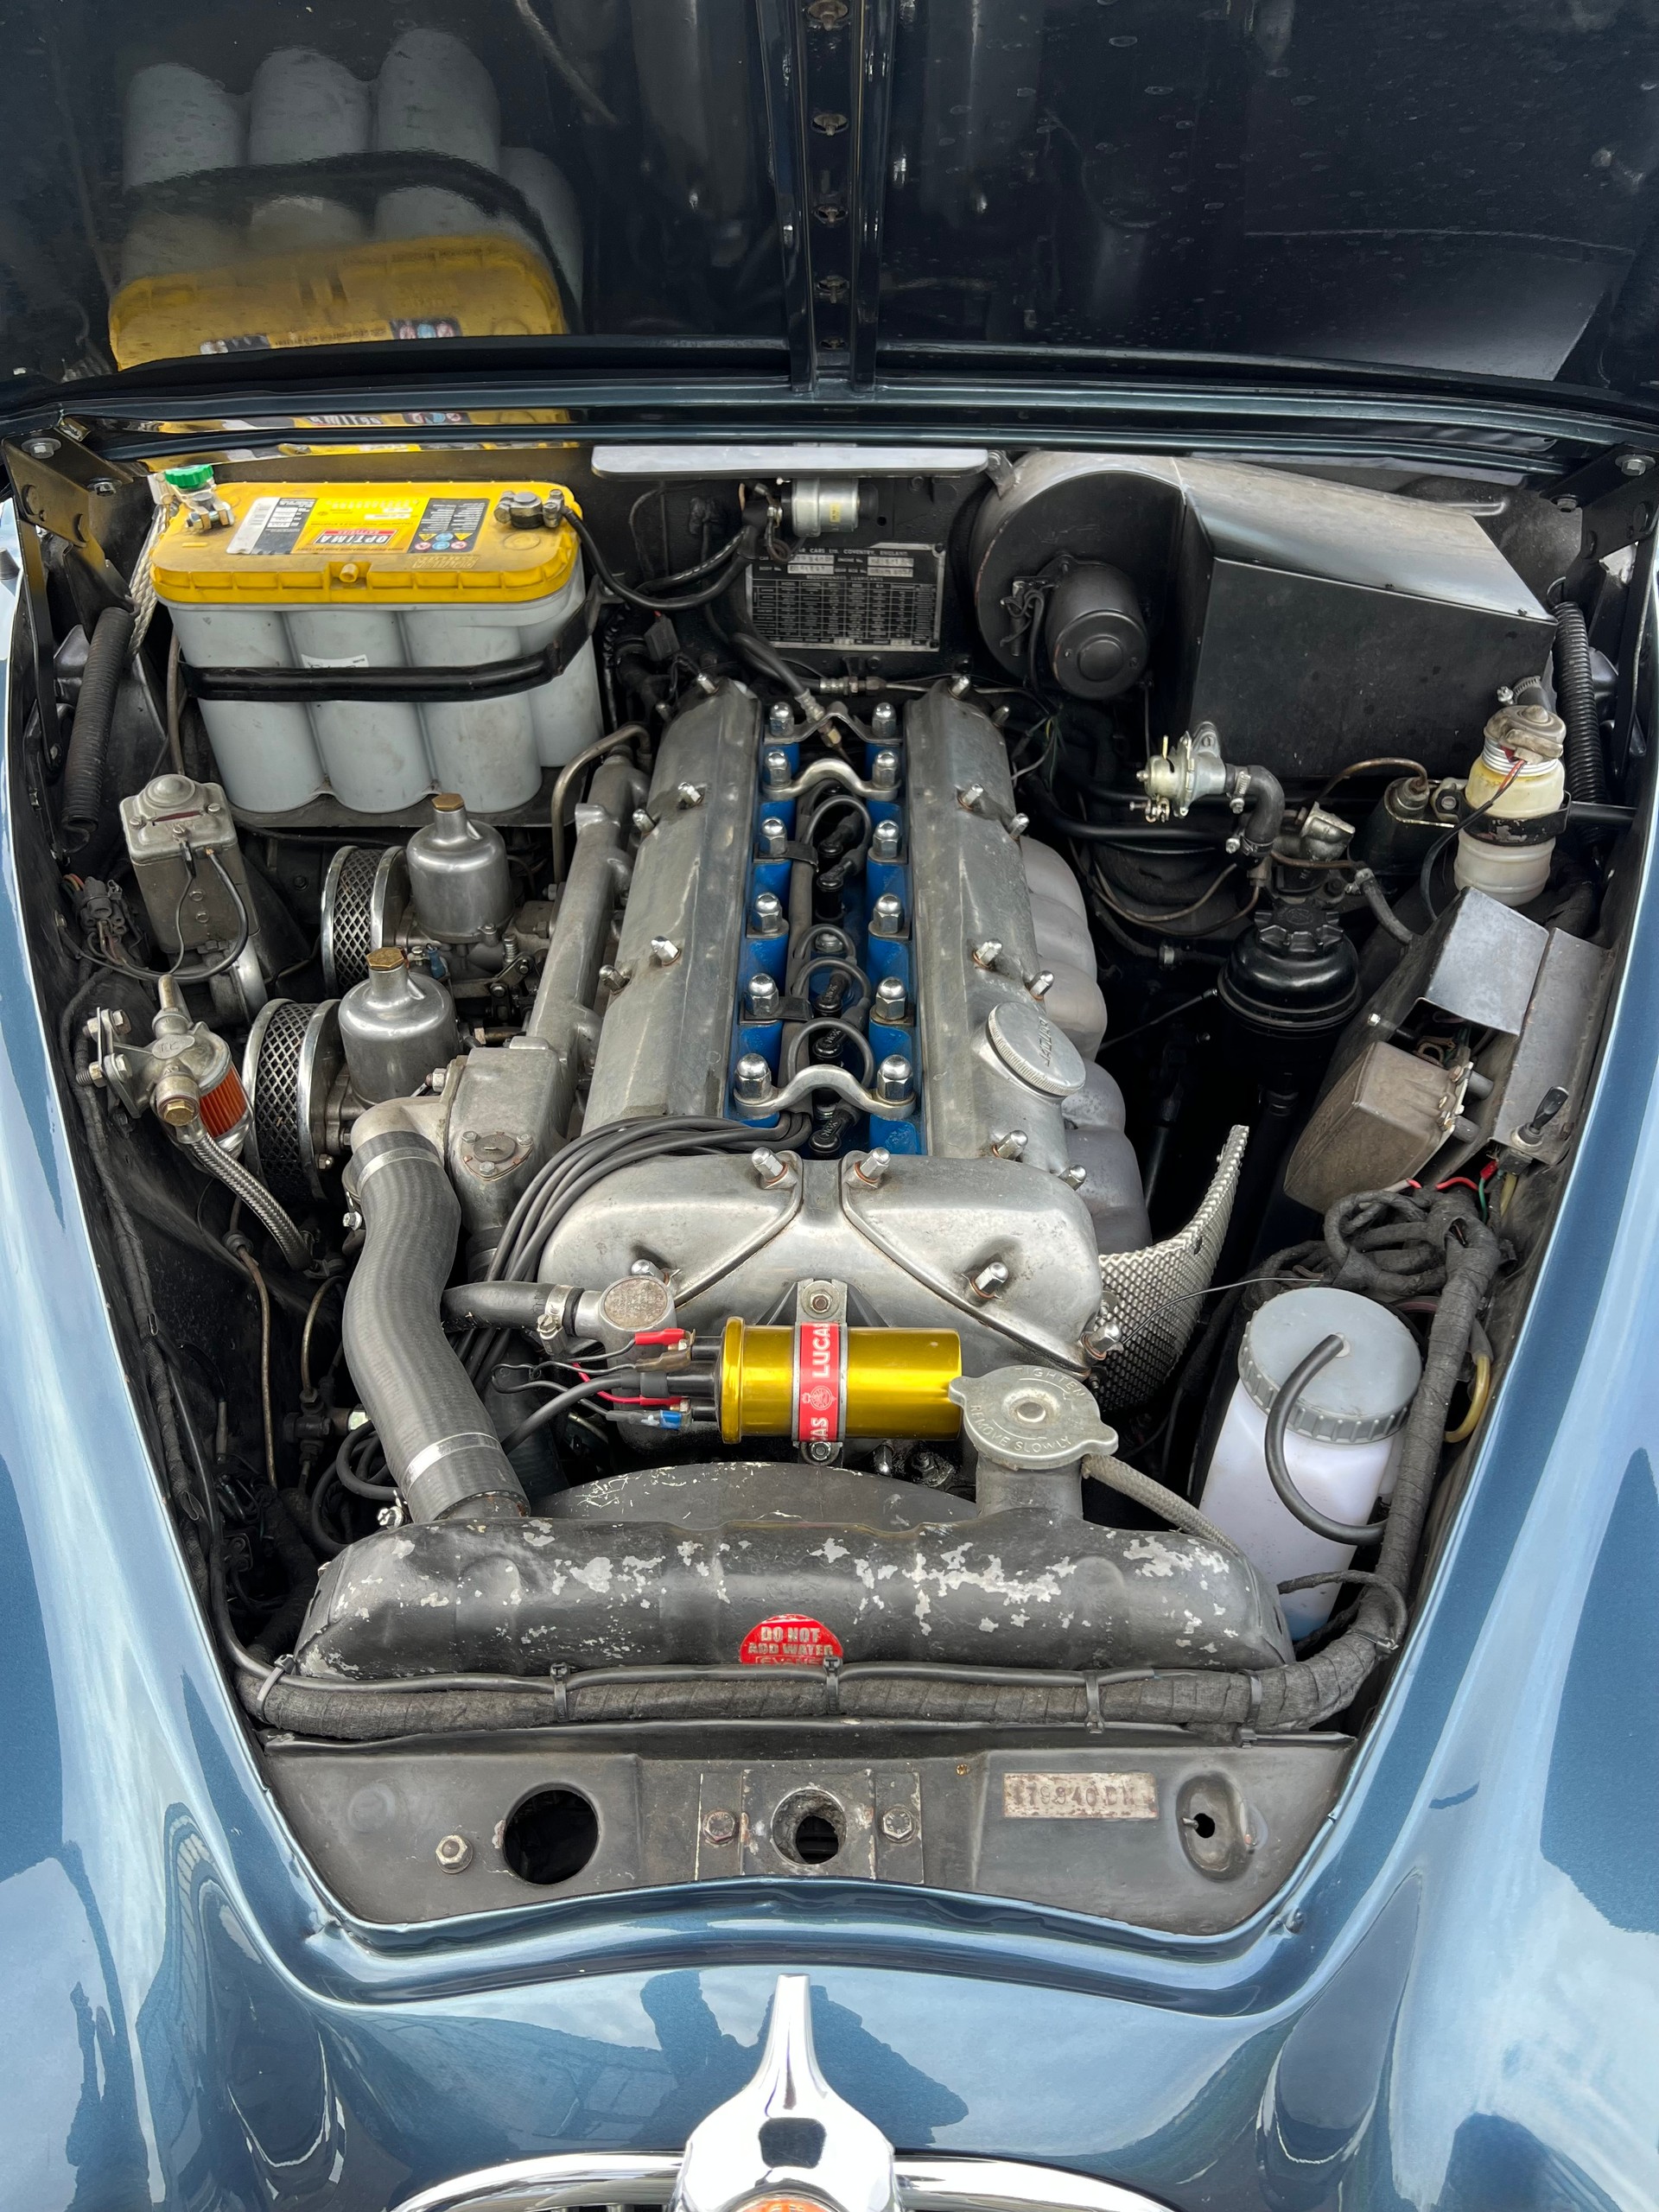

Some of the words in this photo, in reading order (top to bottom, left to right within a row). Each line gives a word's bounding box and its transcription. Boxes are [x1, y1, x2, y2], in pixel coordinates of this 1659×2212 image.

[317, 535, 390, 544] OPTIMA
[1038, 1016, 1053, 1067] JAGUAR
[1015, 1367, 1086, 1397] TIGHTEN
[970, 1404, 1012, 1447] REMOVE
[1014, 1435, 1072, 1453] SLOWLY
[760, 1626, 784, 1643] DO
[787, 1626, 822, 1643] NOT
[747, 1643, 779, 1654] ADD
[782, 1643, 834, 1656] WATER
